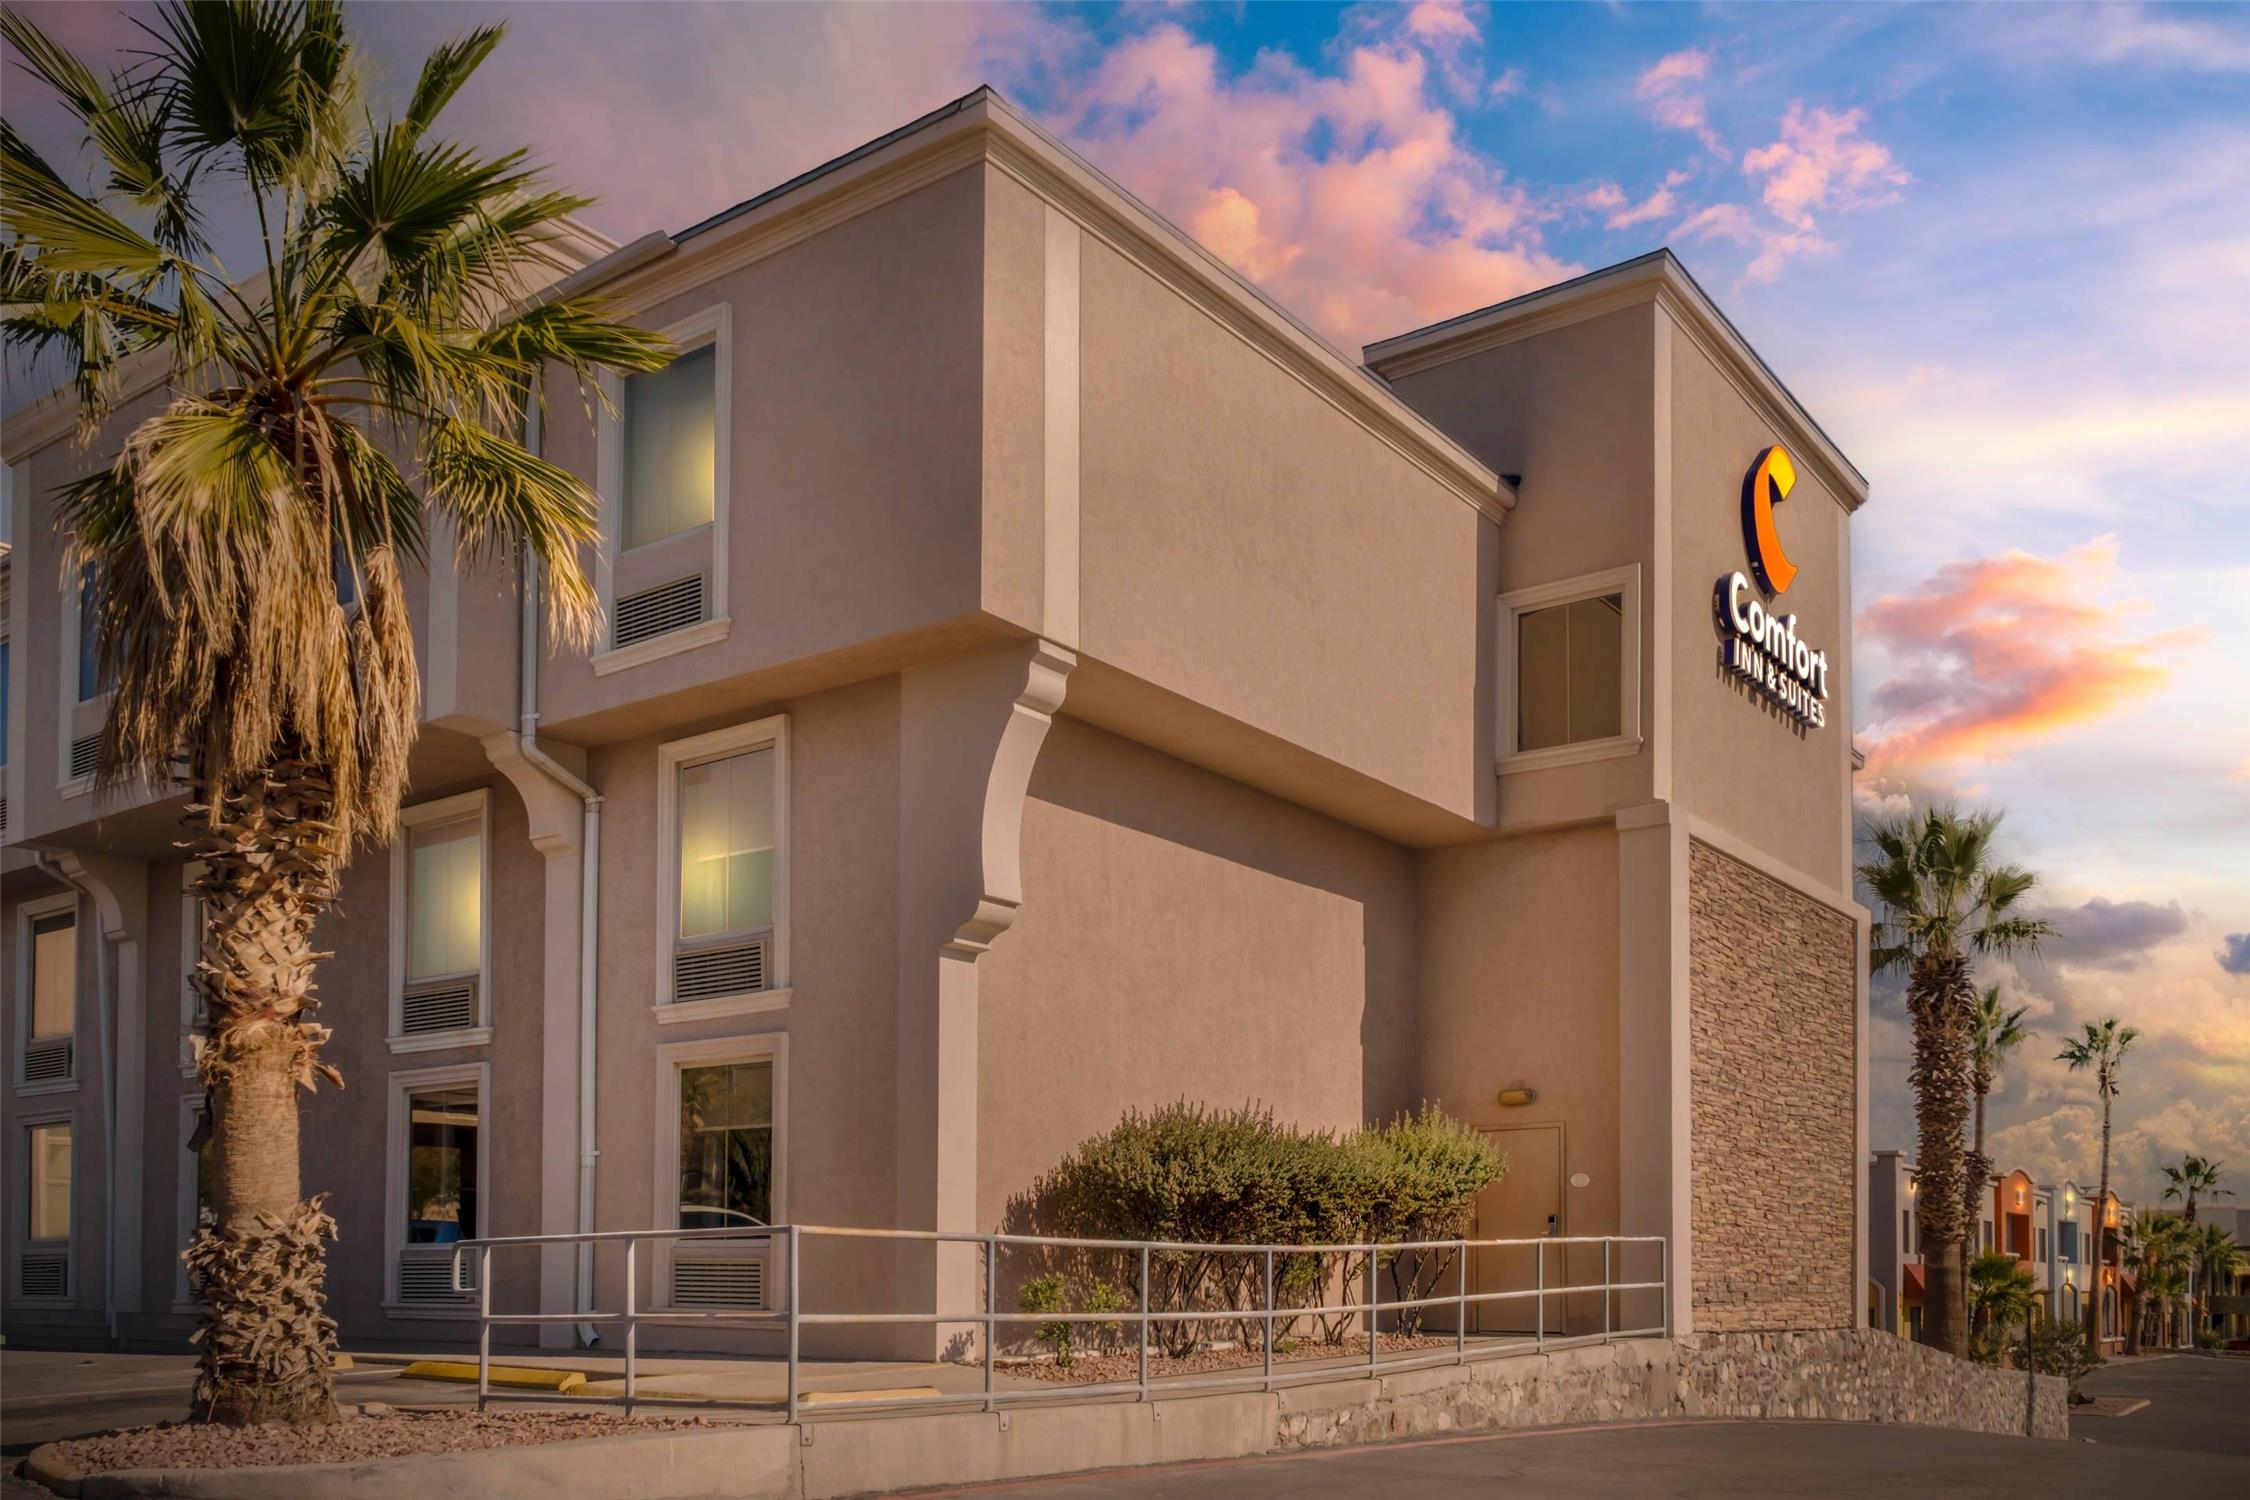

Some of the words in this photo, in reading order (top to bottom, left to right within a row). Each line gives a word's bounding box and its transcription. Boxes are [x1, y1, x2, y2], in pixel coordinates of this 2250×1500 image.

[1729, 571, 1828, 698] Comfort
[1733, 637, 1764, 683] INN
[1767, 661, 1777, 692] &
[1778, 674, 1825, 727] SUITES
